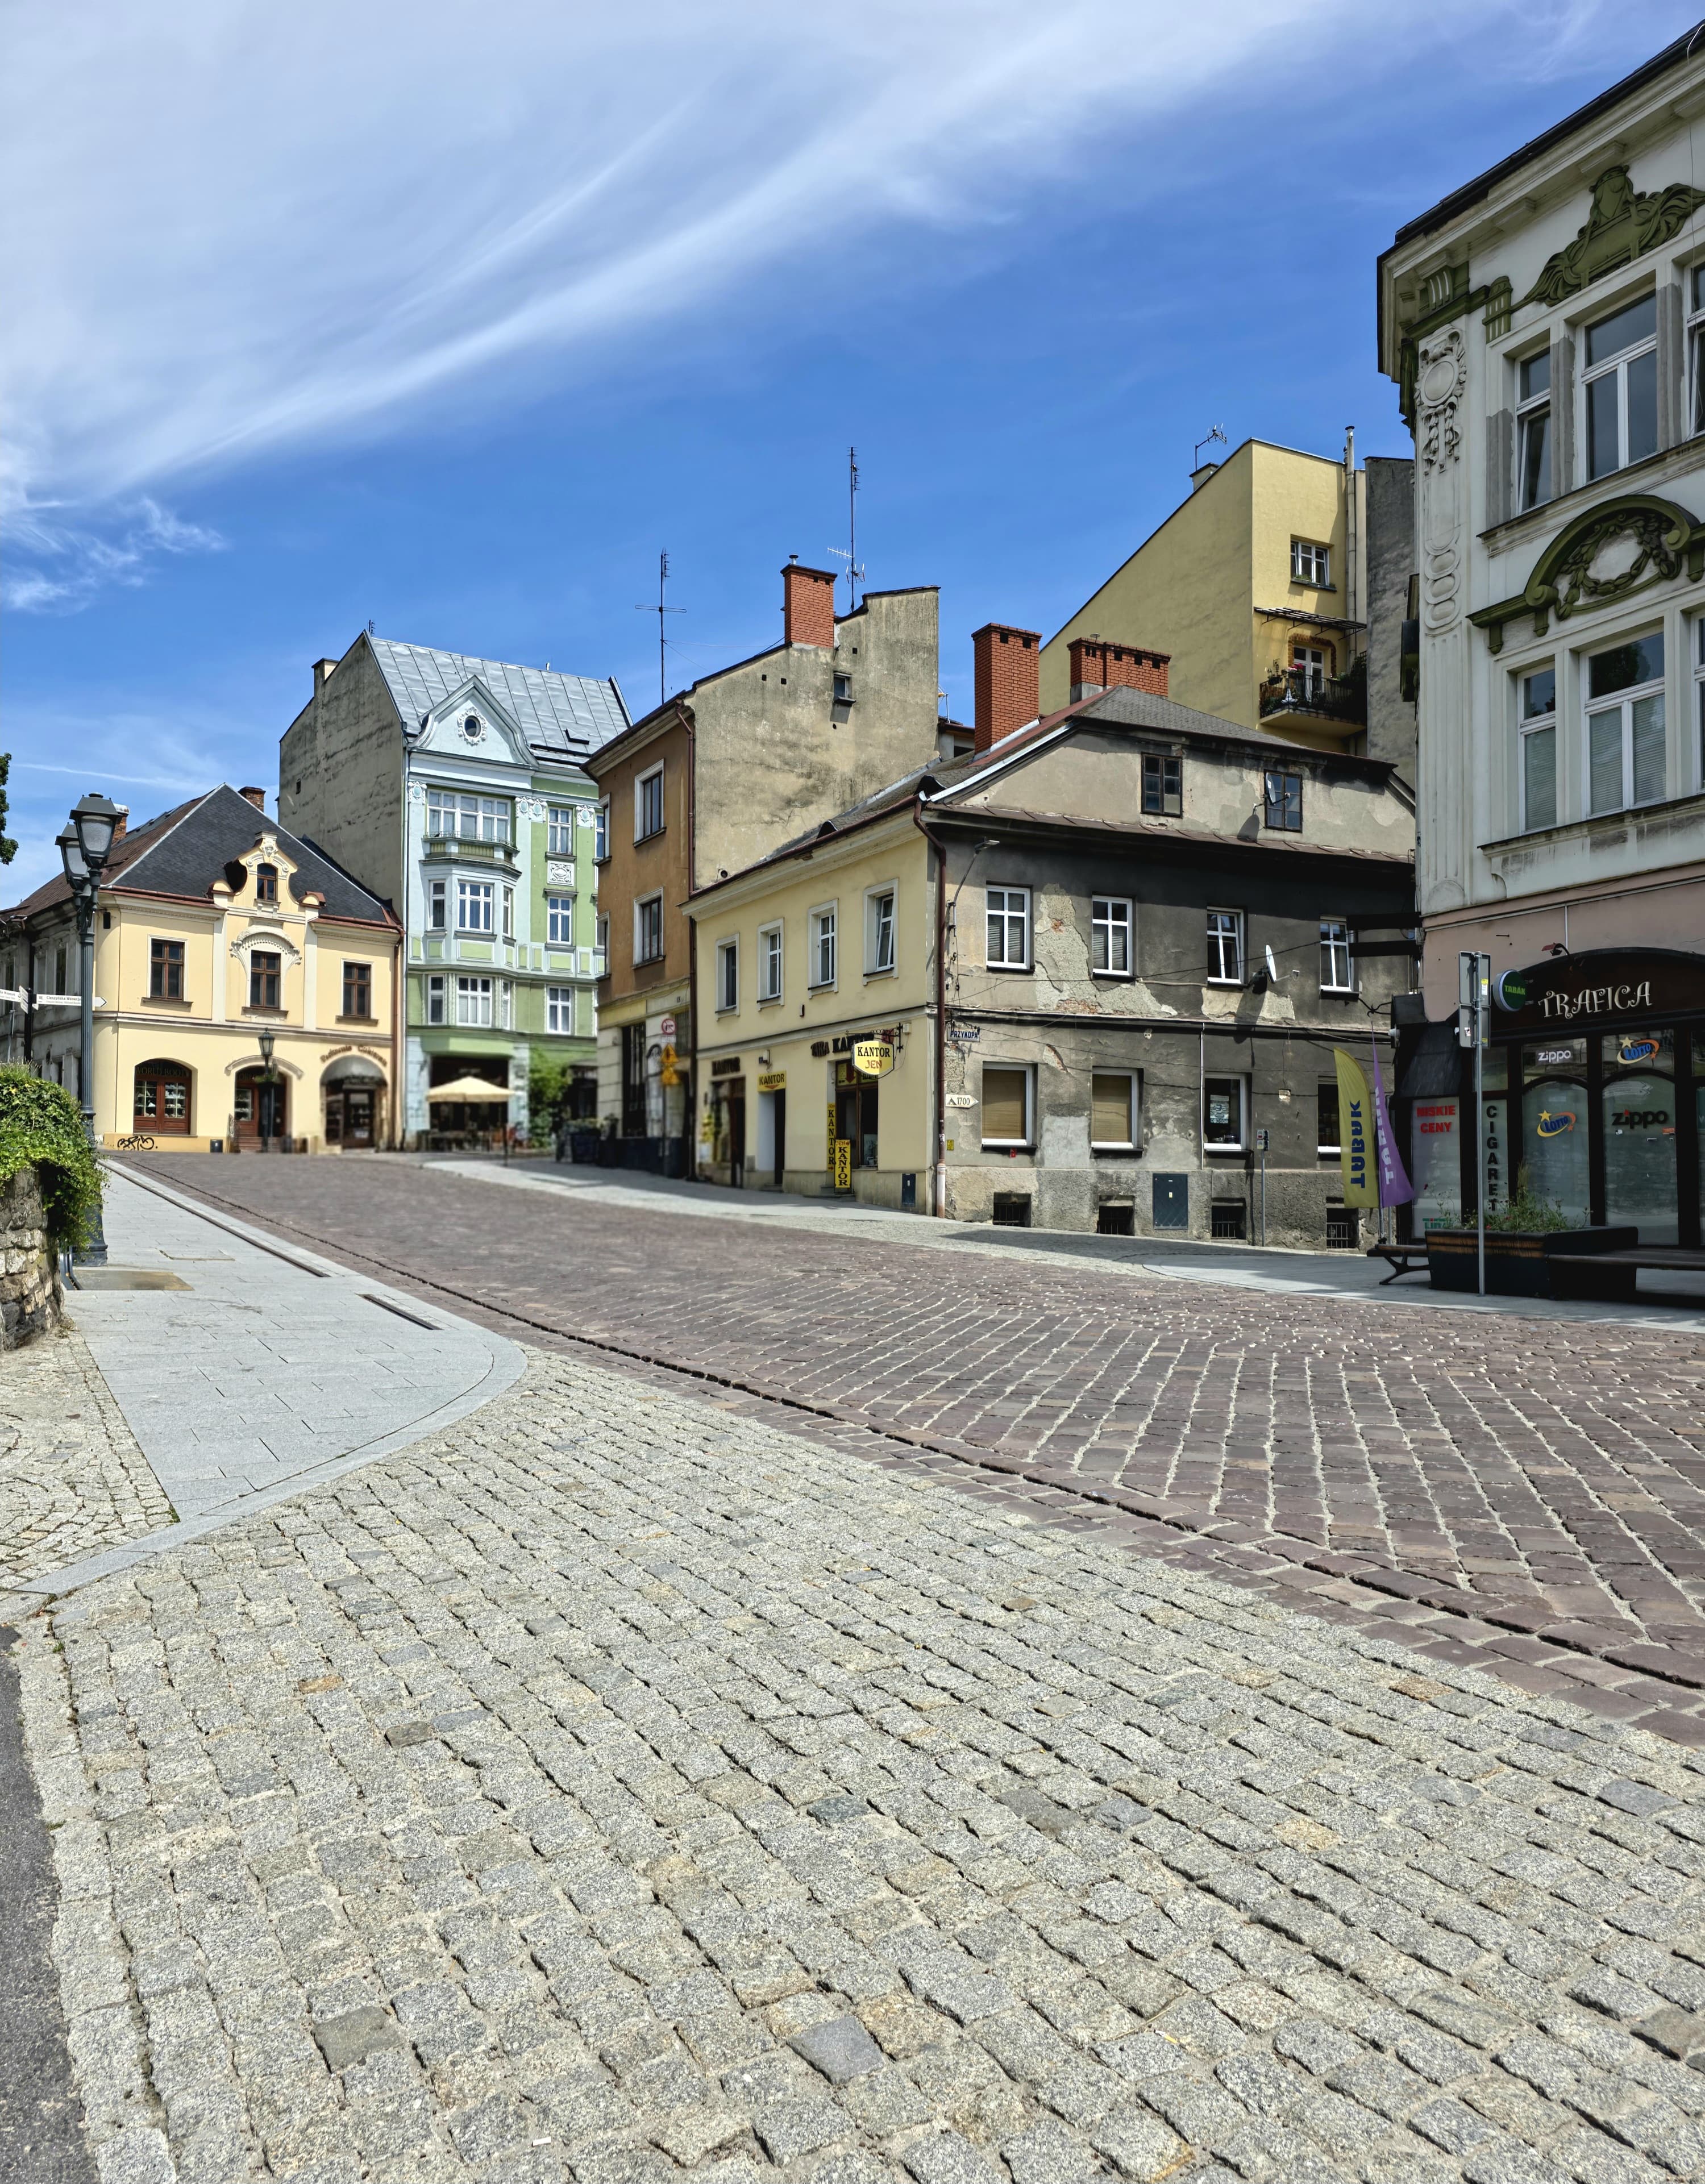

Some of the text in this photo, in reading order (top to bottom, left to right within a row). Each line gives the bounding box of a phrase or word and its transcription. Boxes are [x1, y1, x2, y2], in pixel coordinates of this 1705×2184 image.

[1538, 981, 1653, 1019] TRAFICA
[950, 1030, 978, 1039] PRZYKOPA
[858, 1046, 891, 1058] KANTOR
[1538, 1050, 1571, 1062] zippo
[1623, 1043, 1651, 1060] LOTTO
[865, 1060, 882, 1069] JEN
[759, 1074, 784, 1085] KANTOR
[957, 1097, 970, 1105] 1700
[1416, 1105, 1456, 1117] NISKIE
[1544, 1116, 1569, 1133] LOTTO
[1611, 1109, 1669, 1129] zippo
[1420, 1122, 1452, 1133] CENY
[838, 1146, 848, 1186] KANTOR
